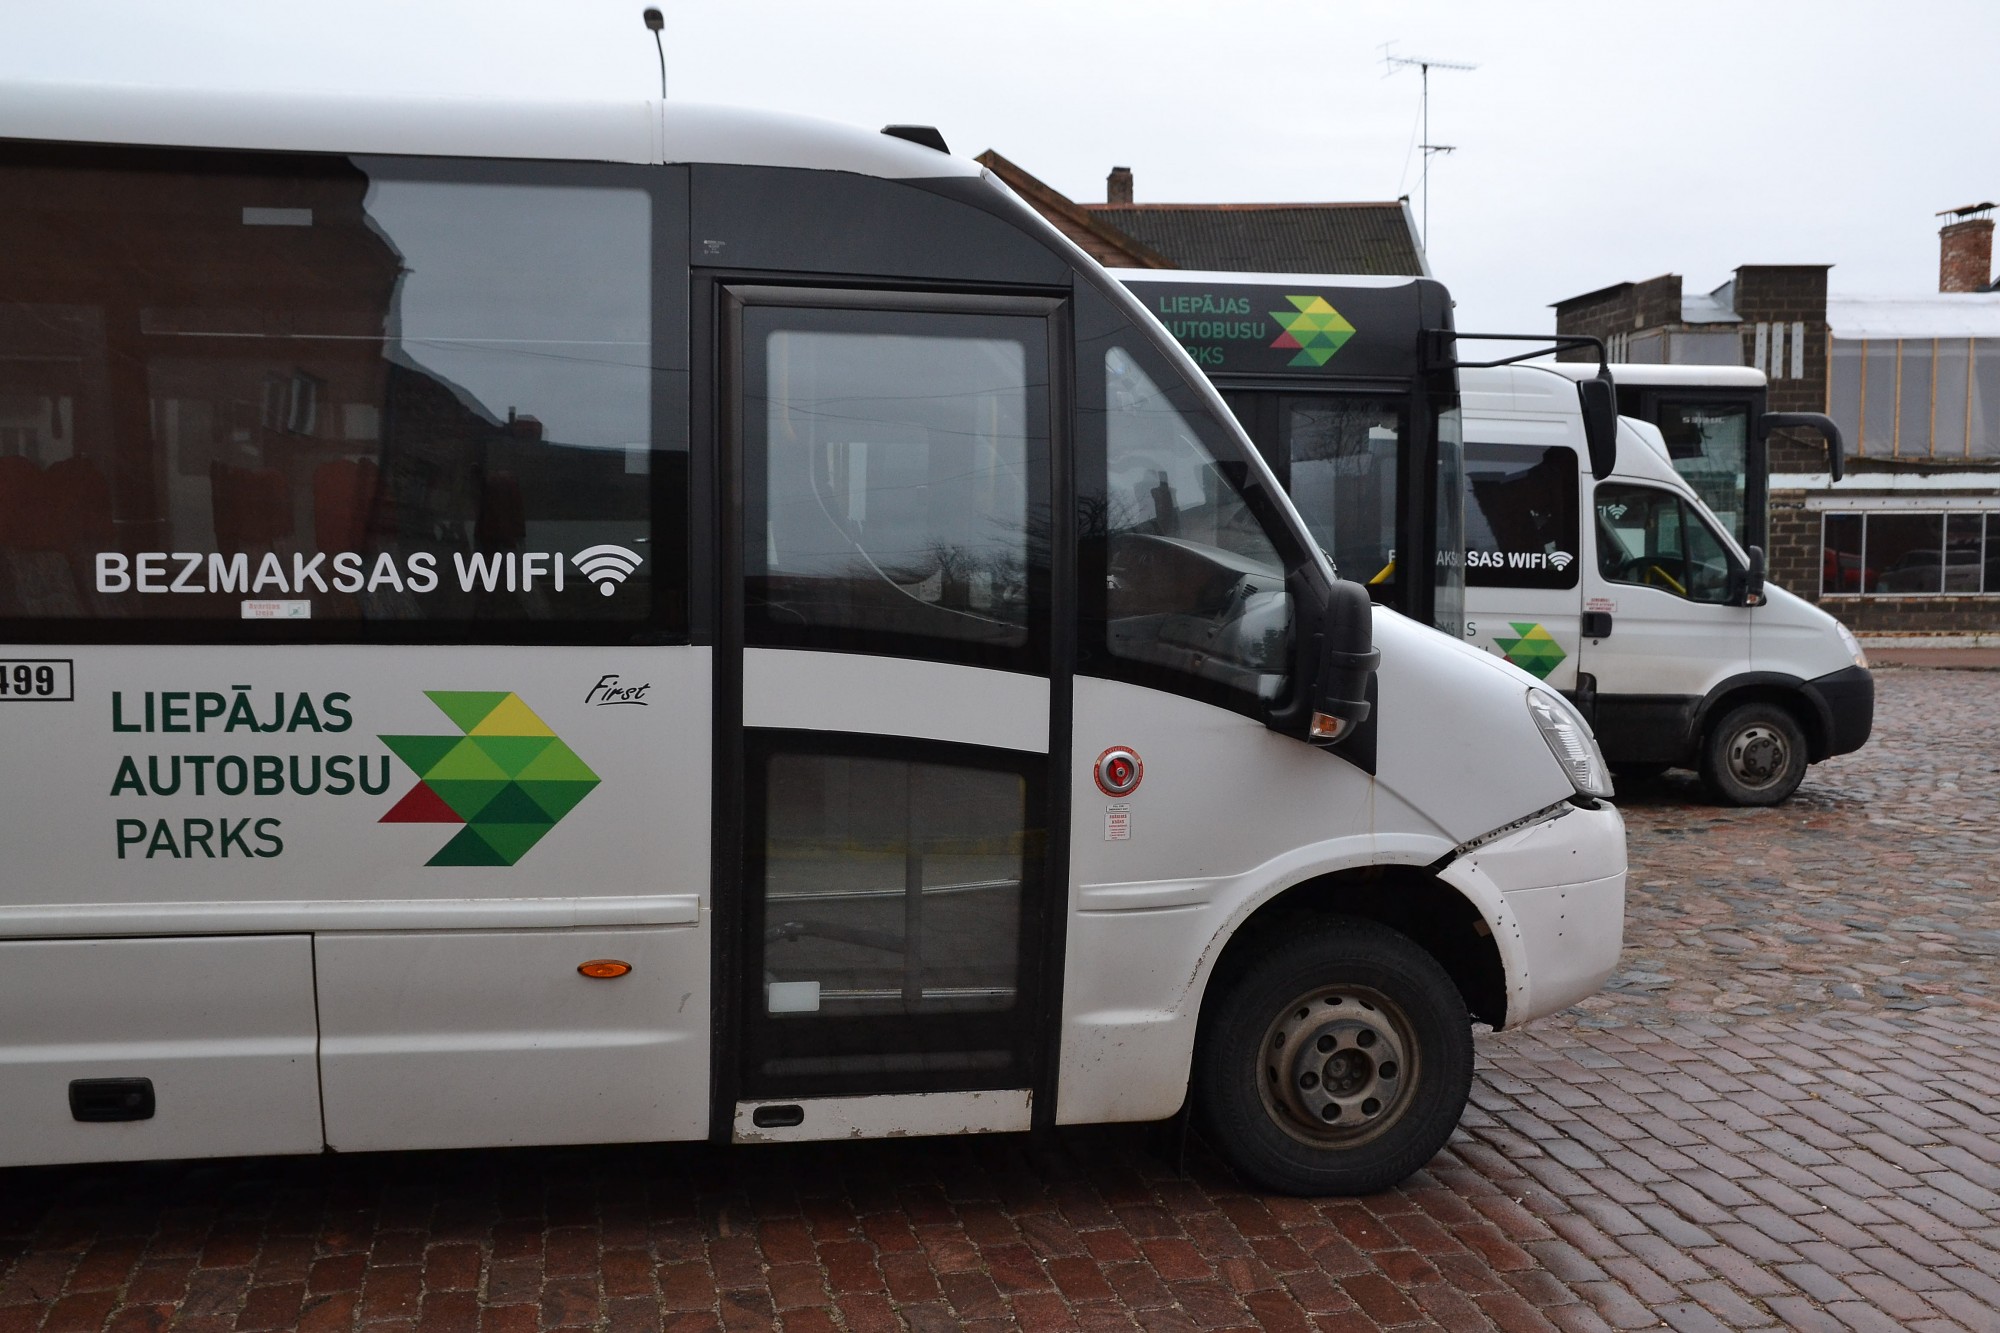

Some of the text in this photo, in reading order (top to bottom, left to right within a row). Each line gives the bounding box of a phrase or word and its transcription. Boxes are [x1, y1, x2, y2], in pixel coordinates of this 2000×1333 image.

[1160, 294, 1251, 315] LIEPĀJAS
[1186, 346, 1225, 365] RKS
[96, 552, 564, 594] BEZMAKSAS WIFI
[1508, 552, 1547, 570] WIFI
[111, 685, 353, 733] LIEPĀJAS
[584, 674, 651, 707] First
[110, 755, 392, 797] AUTOBUSU
[115, 817, 285, 859] PARKS
